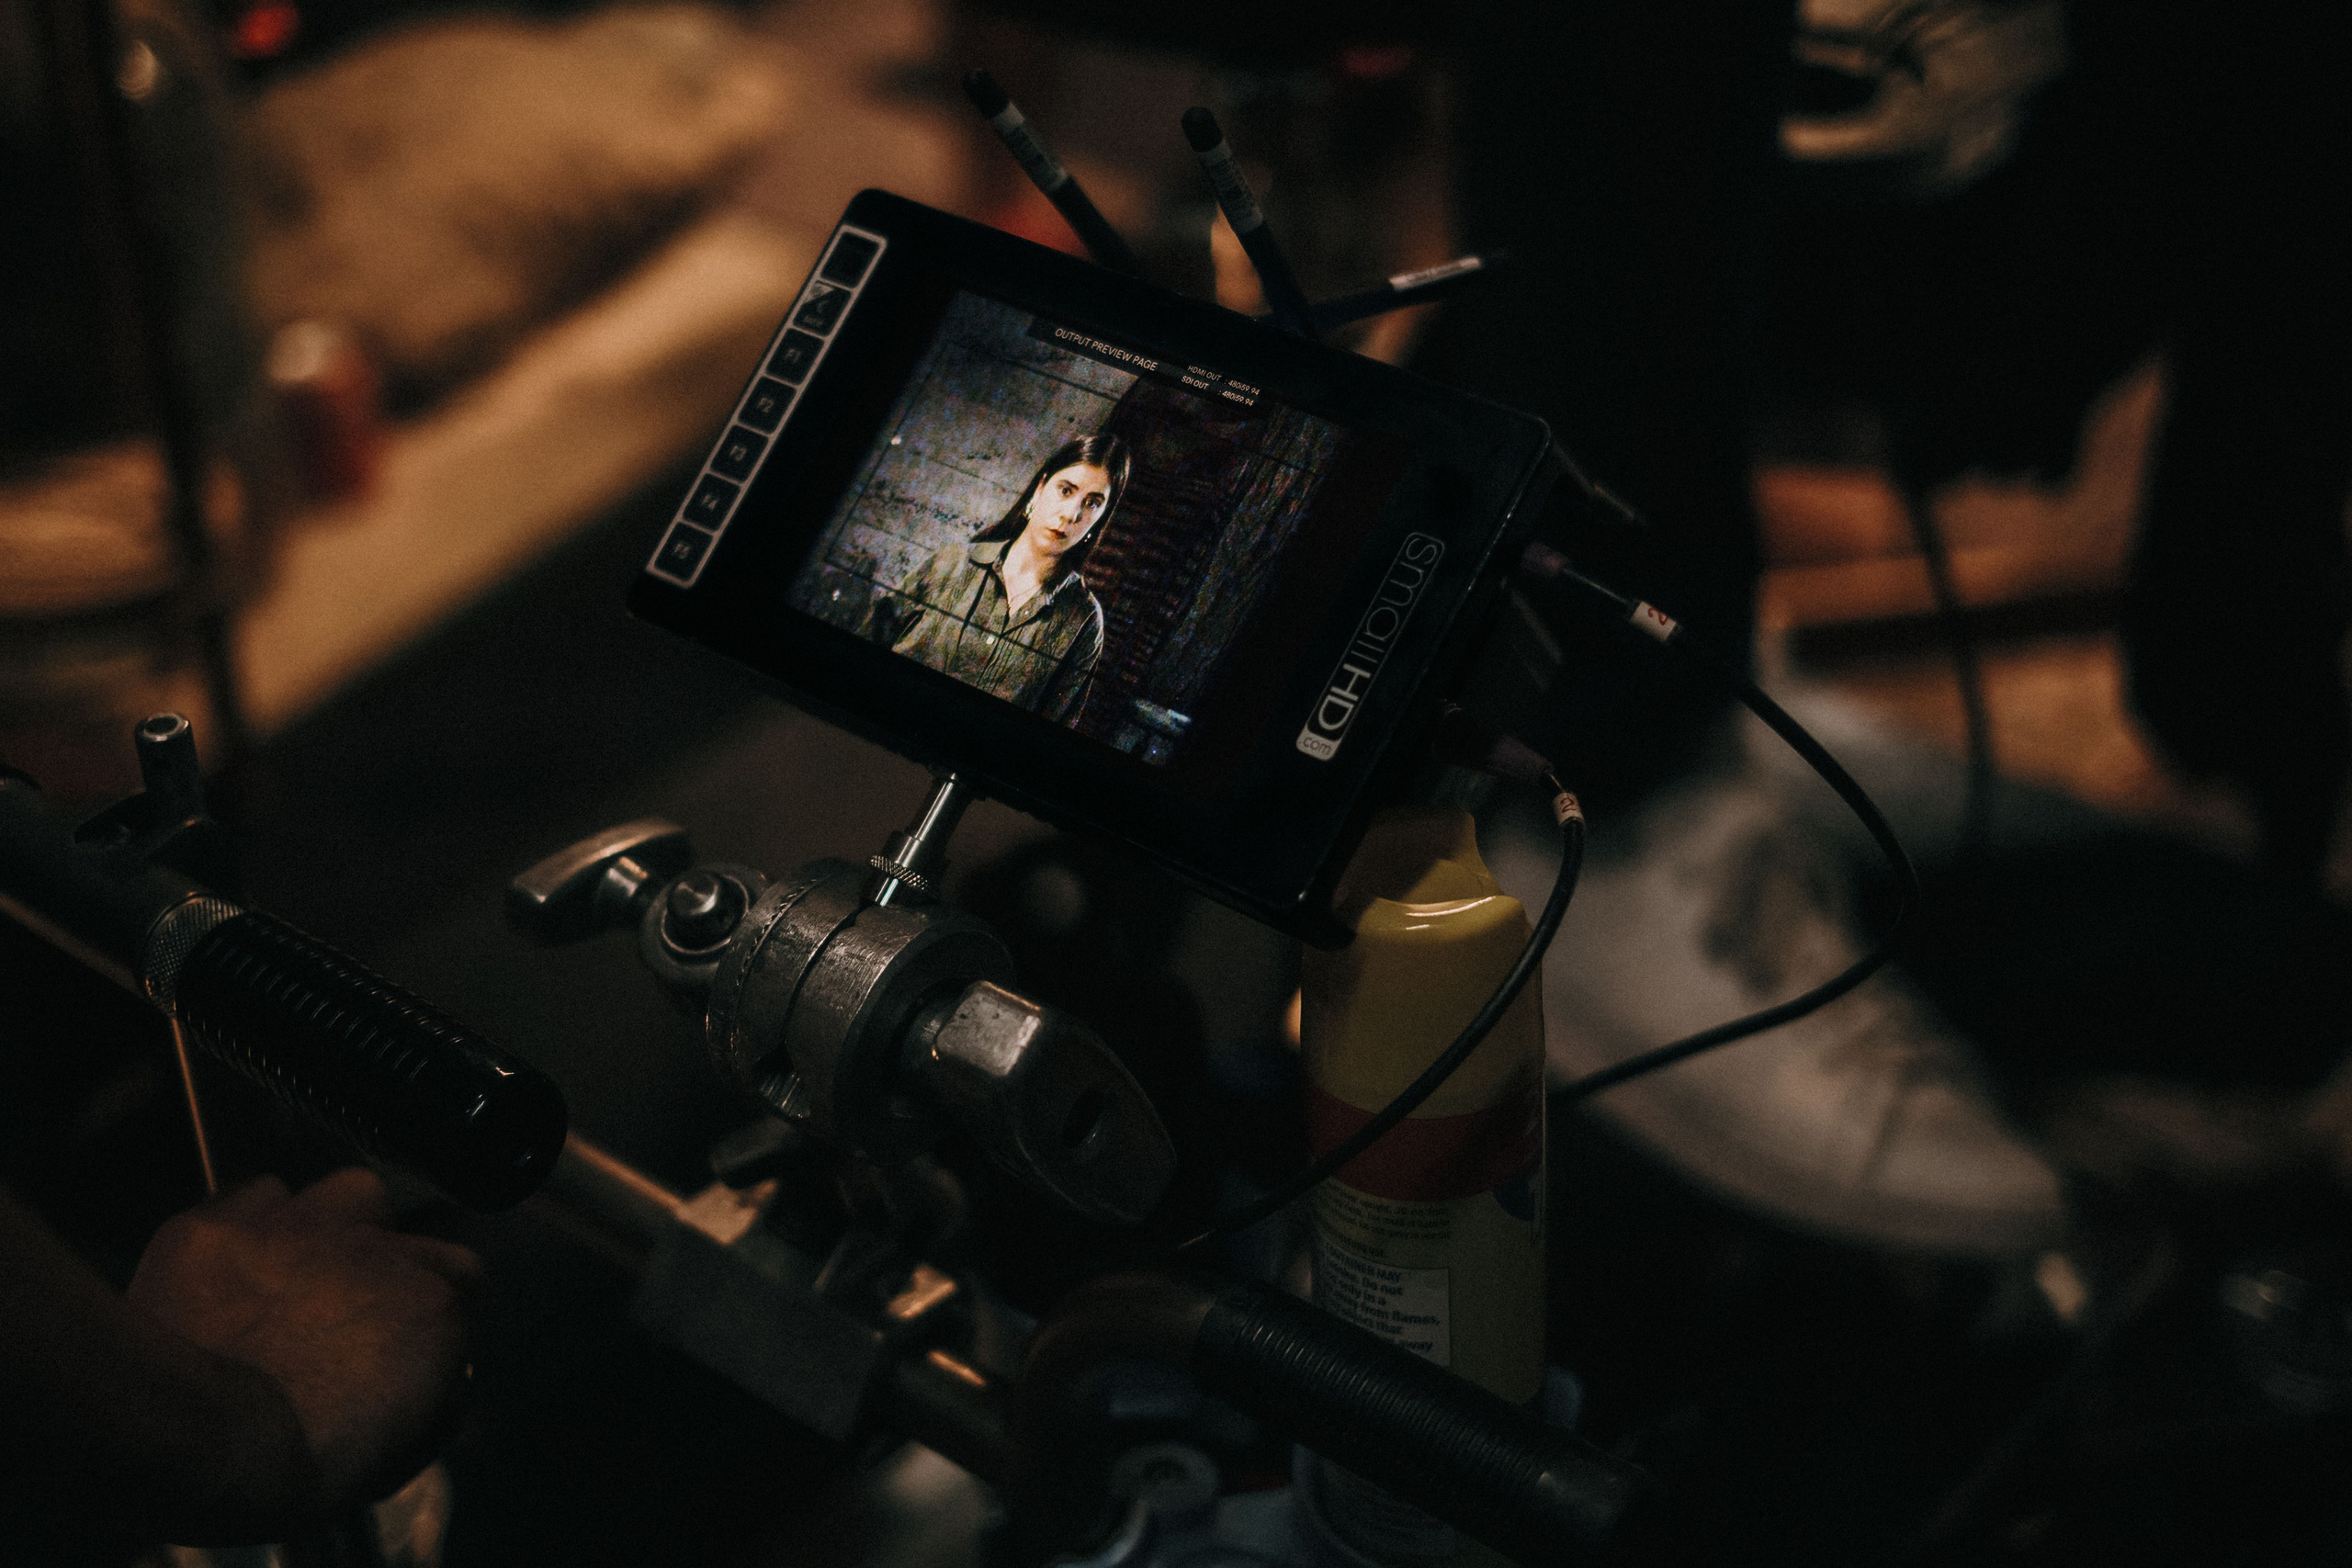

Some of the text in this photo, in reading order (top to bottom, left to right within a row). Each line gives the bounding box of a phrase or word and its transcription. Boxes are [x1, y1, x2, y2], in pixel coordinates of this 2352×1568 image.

[786, 347, 800, 363] F1
[1055, 327, 1159, 372] OUTPUT PREVIEW PAGE
[1187, 365, 1205, 377] HDMI
[1206, 371, 1222, 381] OUT
[1181, 376, 1193, 386] SDI
[1193, 379, 1209, 390] OUT
[758, 397, 774, 413] F2
[701, 493, 718, 511] F4
[1647, 607, 1668, 626] 2
[1317, 537, 1438, 731] smallHD
[1560, 797, 1577, 813] 2
[1377, 1268, 1402, 1283] MAY
[1362, 1277, 1404, 1296] Do not
[1363, 1290, 1375, 1303] in
[1361, 1302, 1389, 1320] from
[1391, 1311, 1442, 1326] flames,
